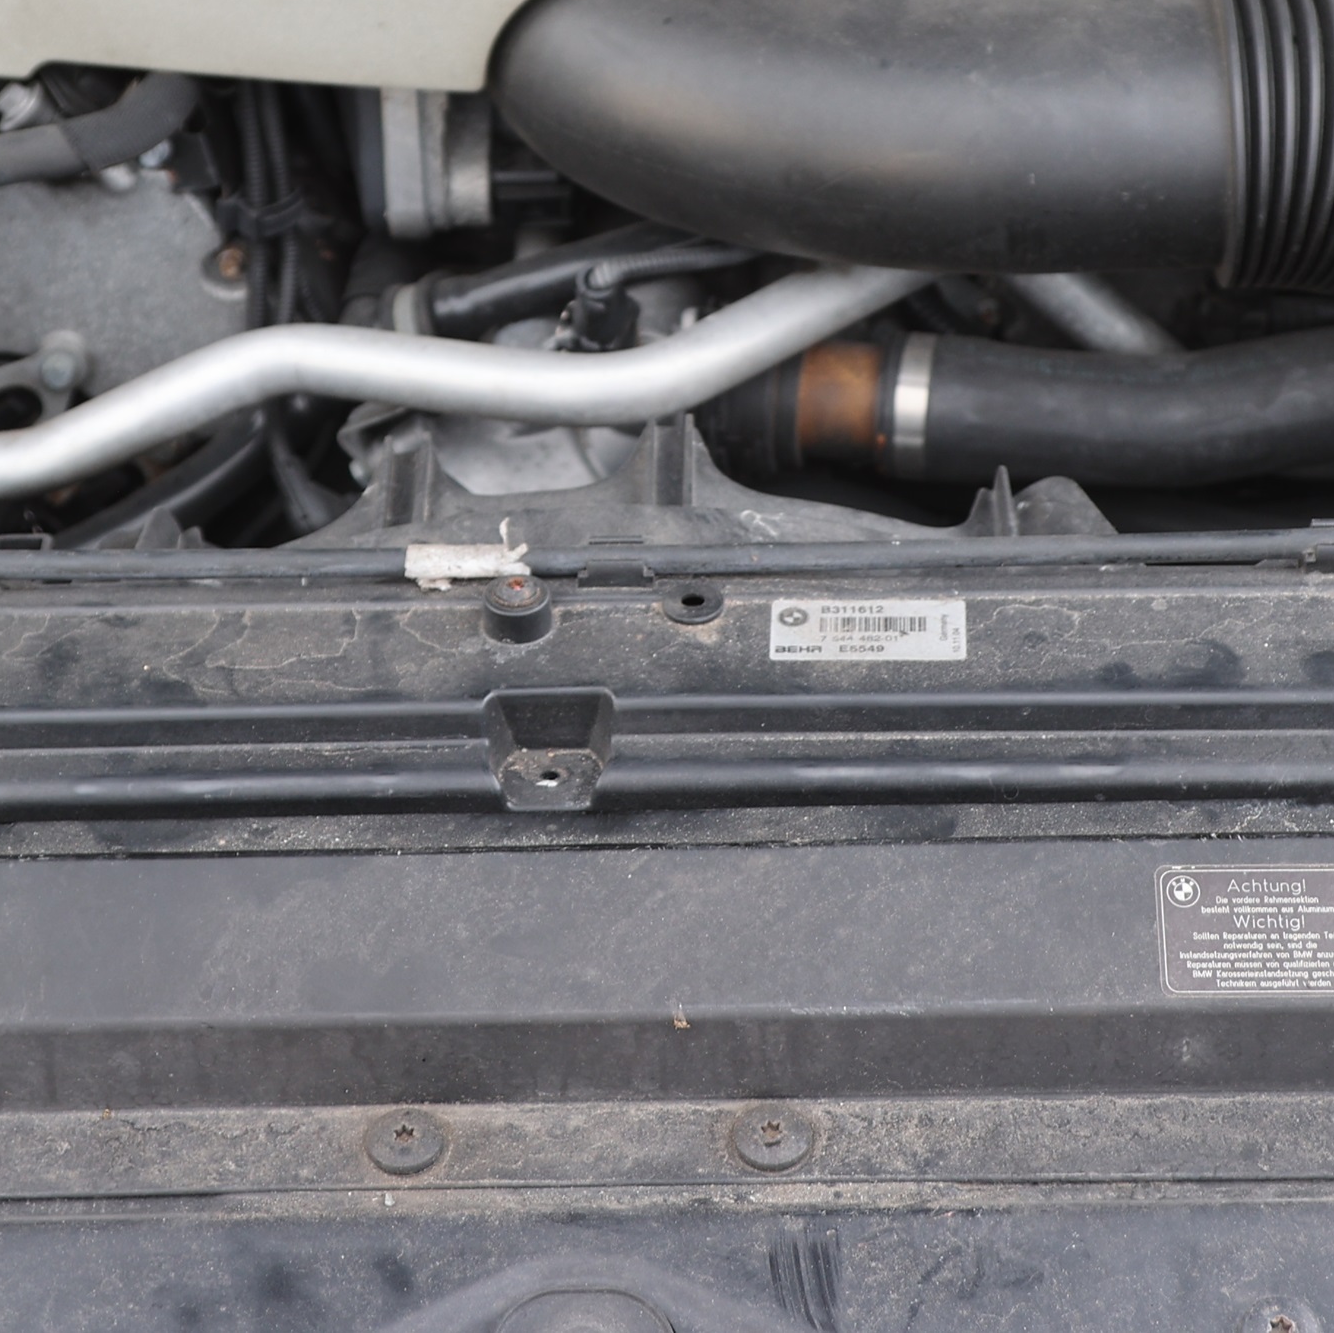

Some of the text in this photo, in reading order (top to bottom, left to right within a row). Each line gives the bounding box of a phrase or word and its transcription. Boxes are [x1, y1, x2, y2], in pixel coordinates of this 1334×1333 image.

[1227, 878, 1306, 895] Achtung!
[1201, 905, 1230, 914] besteht
[1298, 905, 1334, 913] Aluminium
[1233, 915, 1305, 931] Wichtig!
[1193, 932, 1219, 940] Sollten
[1223, 932, 1266, 941] Reparaturen
[1283, 932, 1320, 941] tragenden
[1224, 942, 1263, 950] notwendig
[1288, 941, 1302, 949] sind
[1306, 941, 1317, 949] die
[1187, 961, 1231, 970] Reparaturen
[1193, 970, 1212, 978] BMW
